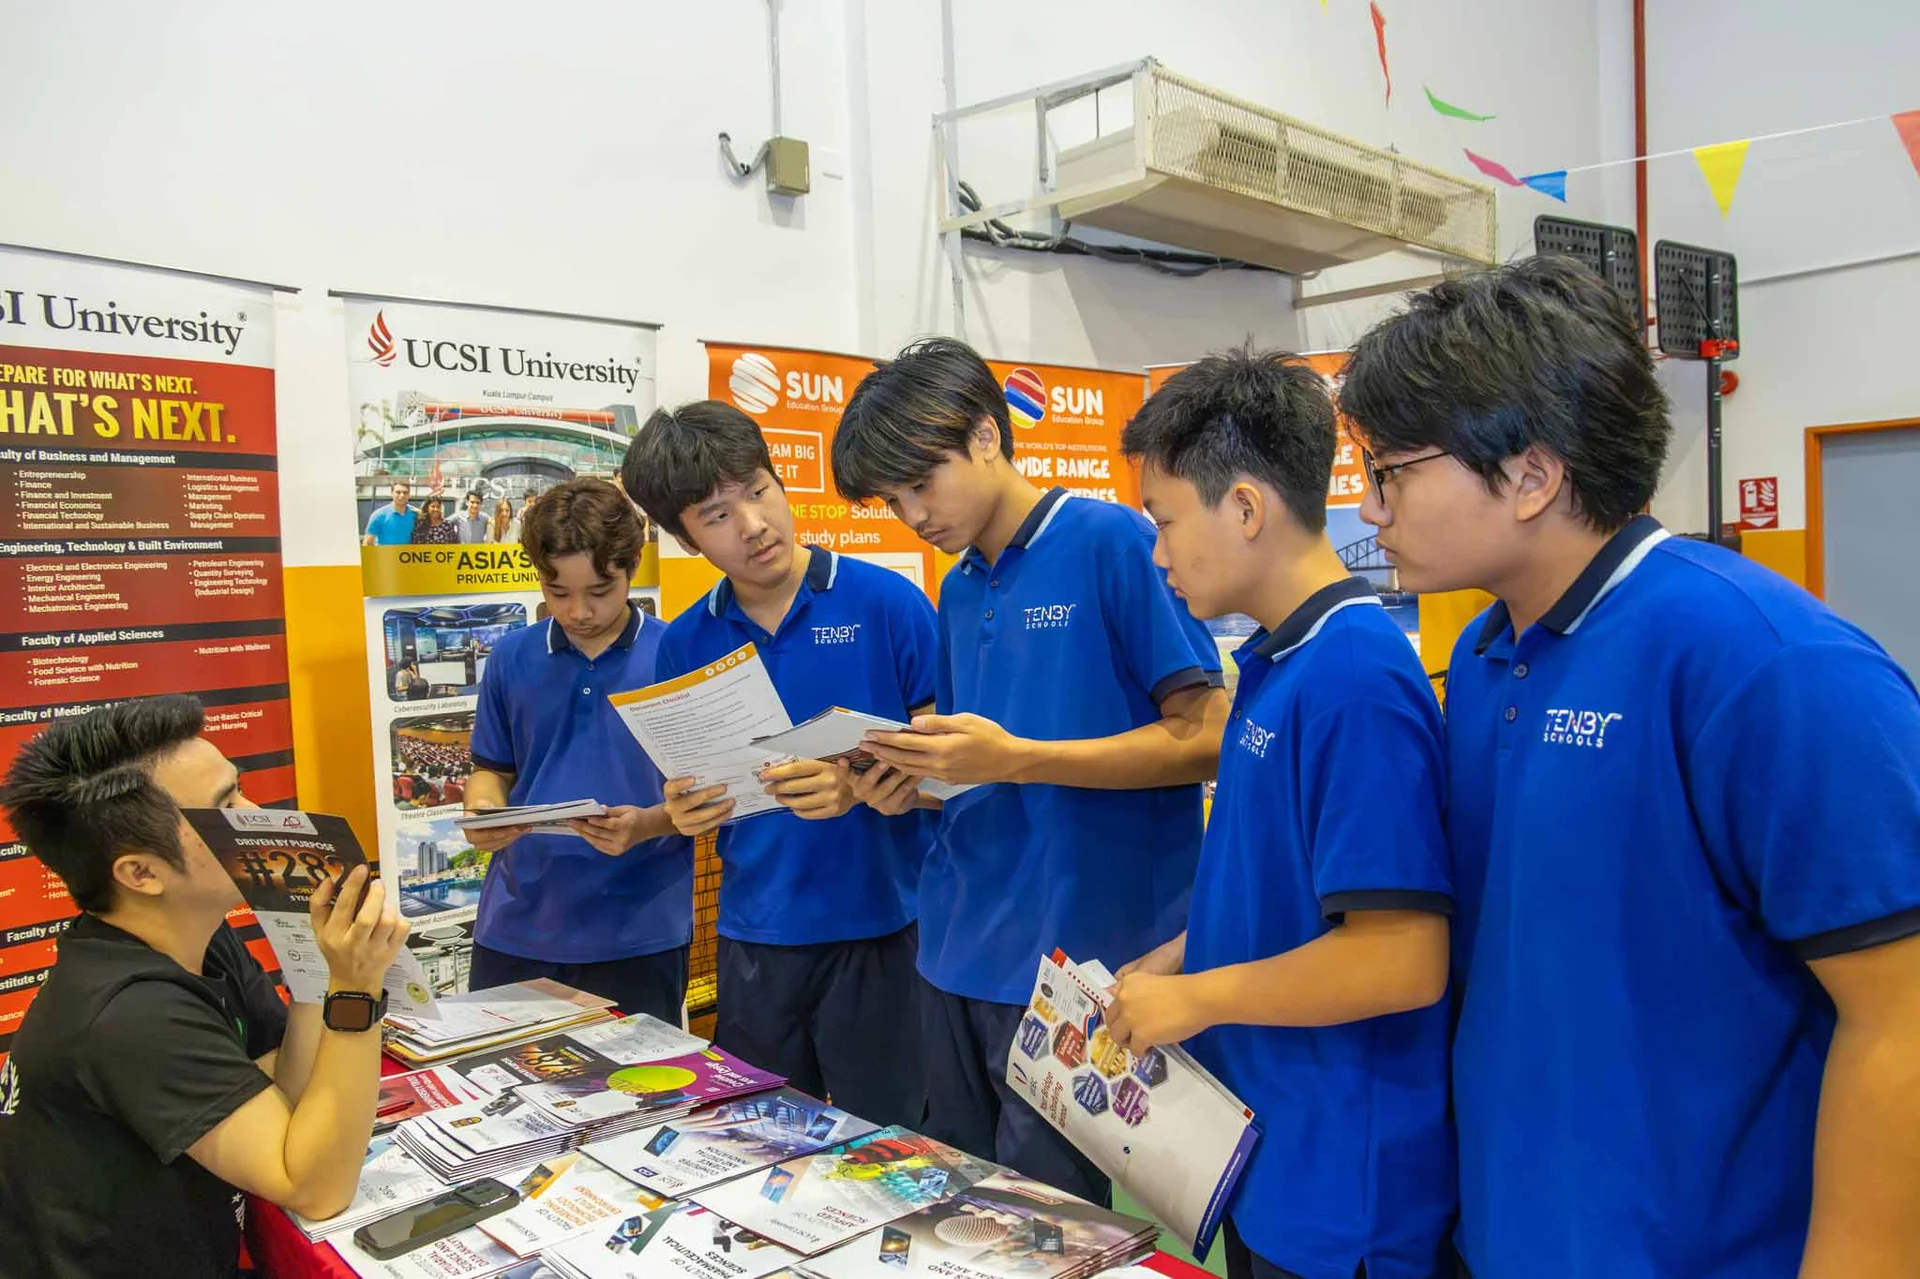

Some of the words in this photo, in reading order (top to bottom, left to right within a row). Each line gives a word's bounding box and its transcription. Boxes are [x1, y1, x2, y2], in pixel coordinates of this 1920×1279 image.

[0, 289, 26, 325] I
[403, 338, 492, 373] UCSI
[498, 347, 639, 393] University
[53, 367, 87, 388] FOR
[89, 370, 152, 392] WHAT'S
[155, 374, 199, 395] NEXT.
[482, 389, 501, 398] Kuala
[786, 371, 843, 404] SUN
[787, 402, 820, 412] Education
[1051, 386, 1104, 416] SUN
[131, 397, 237, 443] NEXT.
[1052, 415, 1083, 425] Education
[1085, 417, 1105, 426] Group
[25, 450, 36, 460] of
[39, 451, 87, 461] Business
[90, 453, 108, 462] and
[111, 453, 176, 465] Management
[795, 444, 815, 460] BIG
[787, 464, 799, 480] IT
[1056, 457, 1110, 479] RANGE
[19, 470, 86, 480] Entrepreneurship
[186, 474, 228, 482] International
[229, 475, 257, 483] Business
[20, 481, 52, 489] Finance
[187, 484, 218, 493] Logistics
[219, 485, 260, 493] Management
[1329, 473, 1364, 496] IES
[21, 491, 52, 499] Finance
[54, 491, 69, 500] and
[71, 491, 113, 500] Investment
[188, 493, 232, 502] Management
[22, 501, 57, 509] Financial
[60, 502, 102, 510] Economics
[189, 503, 223, 511] Marketing
[810, 504, 847, 519] STOP
[23, 512, 58, 520] Financial
[60, 512, 104, 521] Technology
[190, 513, 213, 521] Supply
[23, 522, 73, 530] International
[75, 522, 90, 530] and
[91, 522, 134, 530] Sustainable
[136, 522, 170, 530] Business
[190, 522, 234, 531] Management
[800, 530, 836, 546] study
[840, 530, 881, 548] plans
[67, 541, 126, 553] Technology
[128, 541, 136, 551] &
[138, 541, 161, 551] Built
[164, 541, 223, 551] Environment
[398, 551, 433, 564] ONE
[437, 551, 454, 564] OF
[457, 550, 533, 570] ASIA'S
[26, 563, 63, 572] Electrical
[65, 563, 79, 571] and
[81, 562, 123, 571] Electronics
[124, 561, 168, 571] Engineering
[26, 574, 54, 583] Energy
[55, 573, 101, 583] Engineering
[457, 573, 509, 585] PRIVATE
[512, 572, 541, 584] UNIV
[27, 585, 57, 593] Interior
[58, 583, 106, 592] Architecture
[28, 594, 74, 603] Mechanical
[75, 593, 120, 603] Engineering
[29, 604, 82, 613] Mechatronics
[84, 602, 128, 612] Engineering
[1023, 603, 1077, 623] TENBY
[1025, 620, 1070, 629] SCHOOLS
[21, 635, 61, 647] Faculty
[63, 633, 75, 644] of
[77, 631, 117, 644] Applied
[118, 629, 165, 641] Sciences
[811, 624, 861, 640] TENBY
[815, 637, 855, 645] SCHOOLS
[199, 645, 229, 654] Nutrition
[32, 655, 90, 666] Biotechnology
[33, 667, 54, 676] Food
[55, 665, 87, 674] Science
[87, 664, 104, 672] with
[105, 661, 138, 671] Nutrition
[34, 677, 68, 686] Forensic
[70, 674, 100, 683] Science
[40, 708, 51, 719] of
[204, 724, 220, 732] Care
[221, 721, 248, 730] Nursing
[1546, 709, 1623, 737] TENBY
[1543, 733, 1604, 748] SCHOOLS
[234, 837, 275, 847] DRIVEN
[277, 838, 289, 847] BY
[291, 840, 336, 852] PURPOSE
[6, 926, 46, 943] Faculty
[48, 922, 61, 934] of
[0, 974, 35, 990] stitute
[37, 969, 49, 981] of
[446, 1236, 474, 1255] ANALYT
[704, 1250, 748, 1275] SCIENCES
[940, 1261, 973, 1274] ARTS
[927, 1264, 954, 1276] AND
